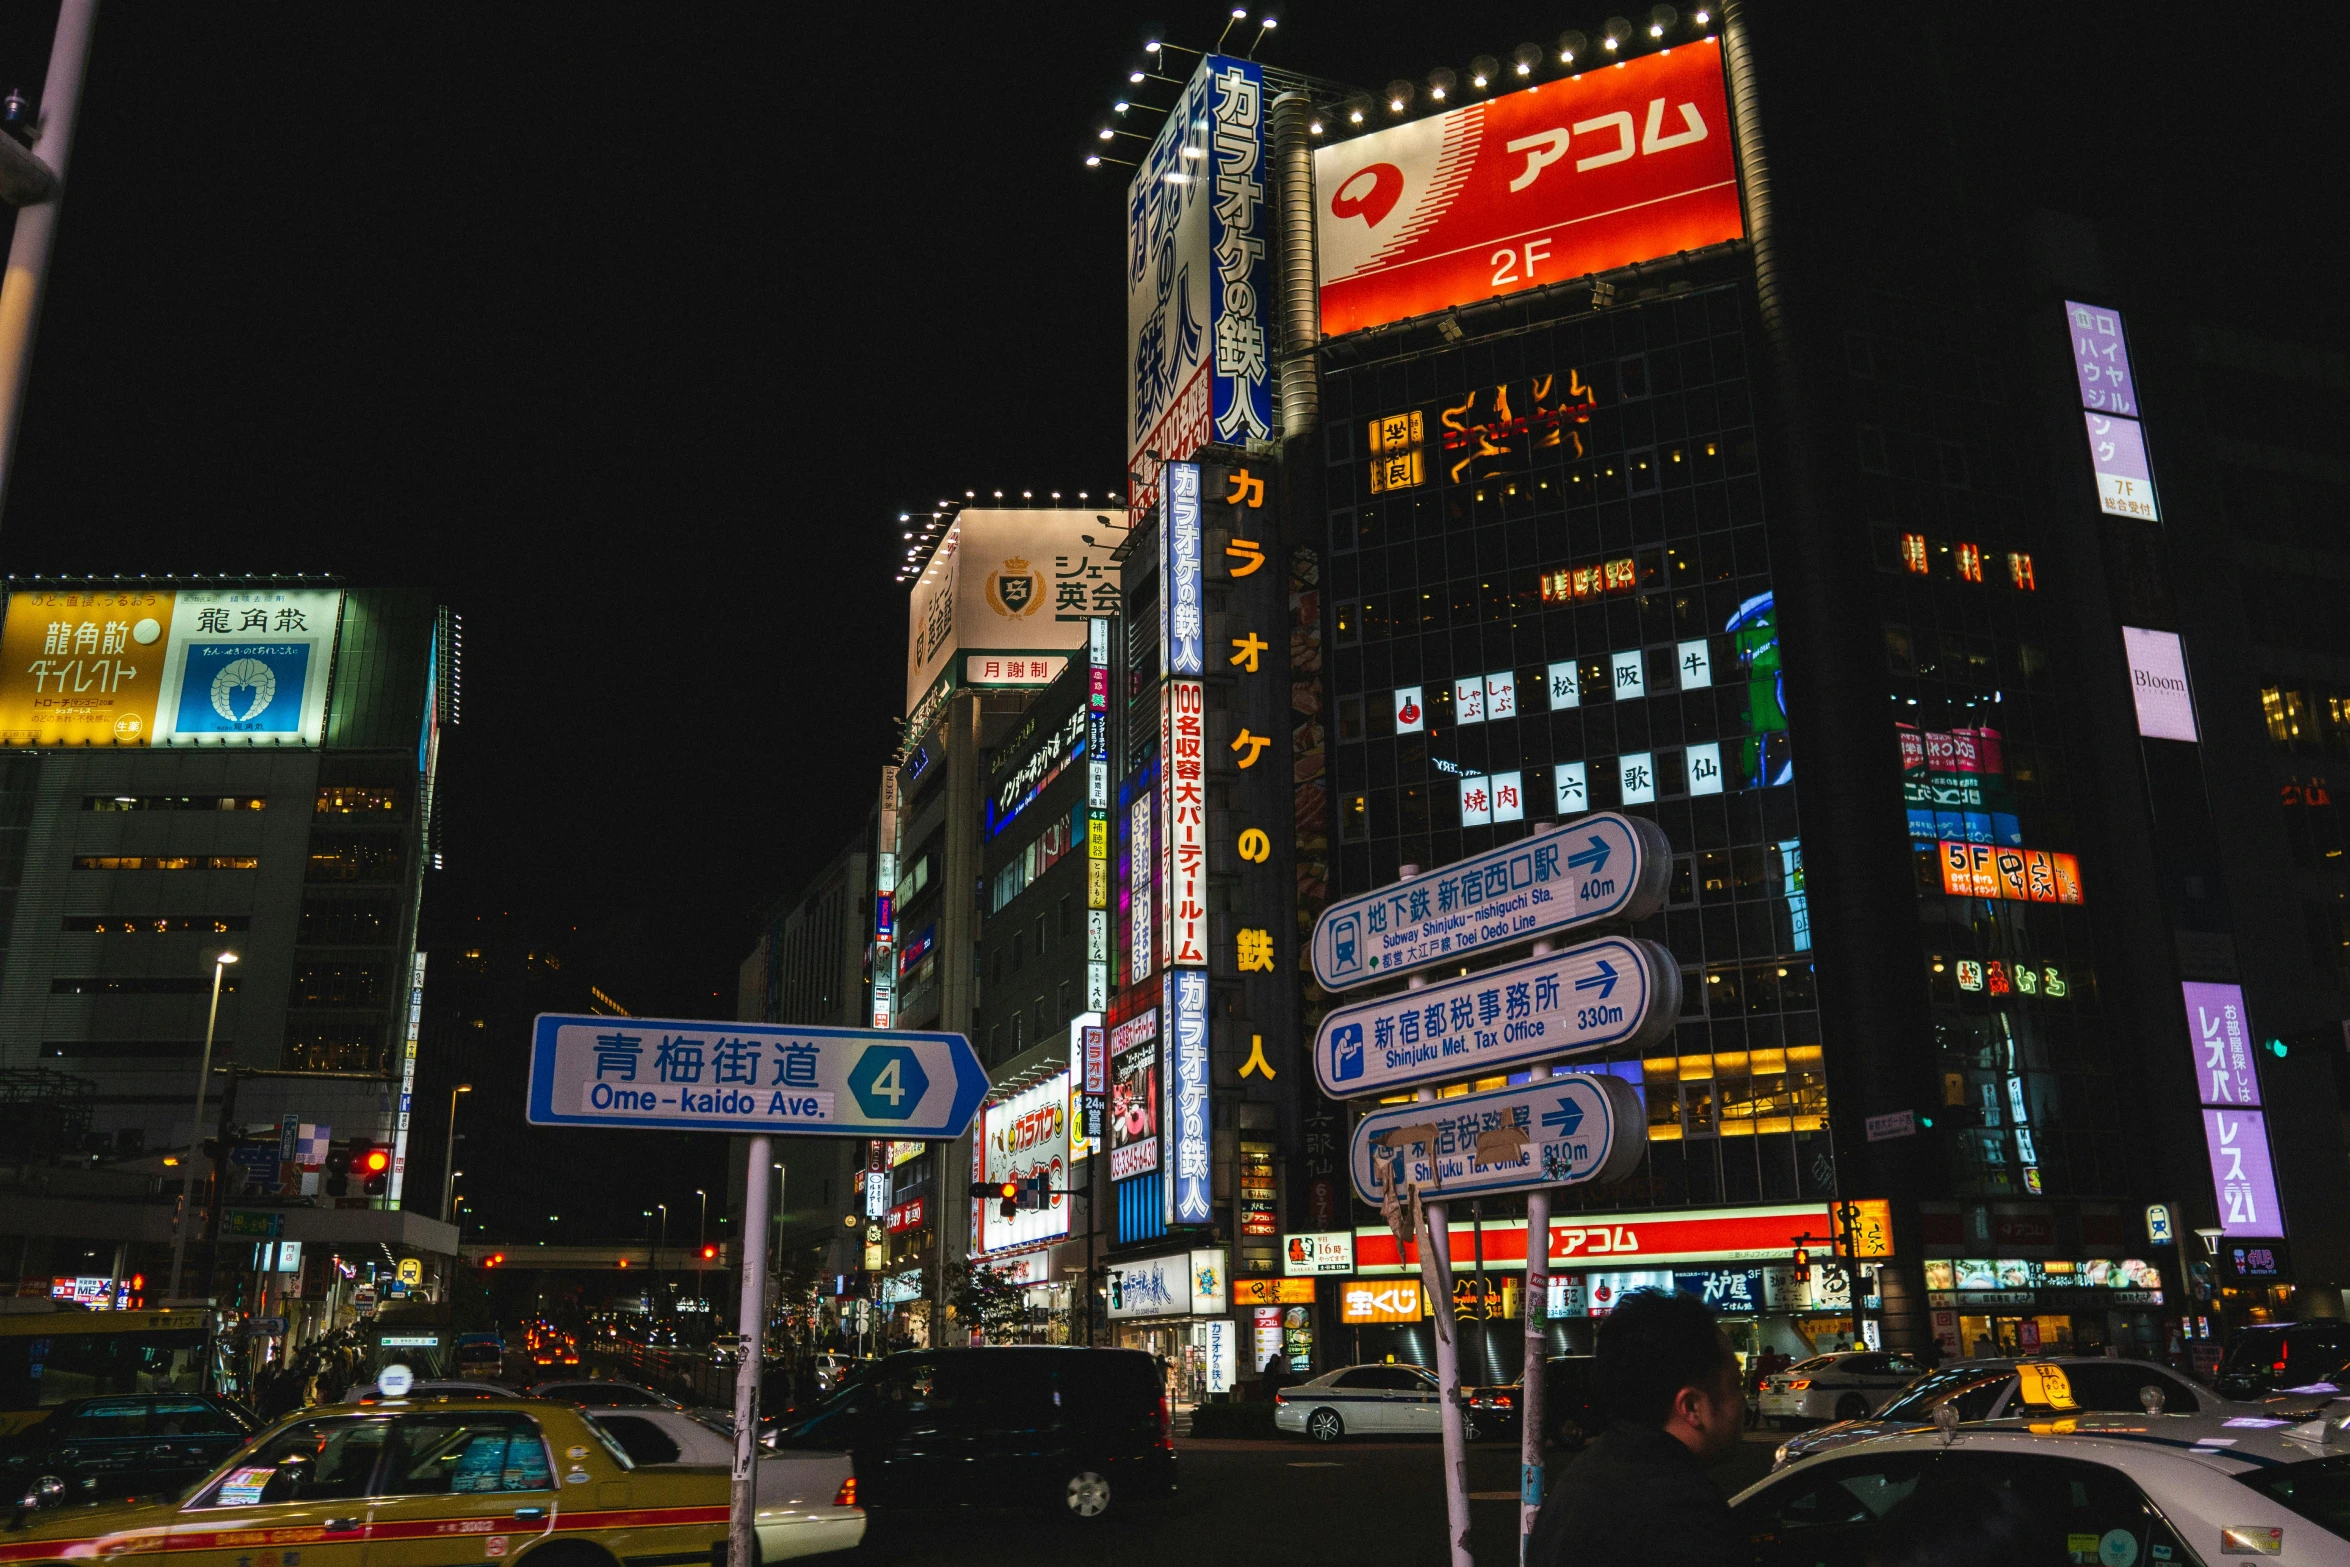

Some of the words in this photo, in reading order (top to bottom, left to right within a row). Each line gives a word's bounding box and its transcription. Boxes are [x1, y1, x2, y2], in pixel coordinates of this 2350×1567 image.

[1507, 98, 1708, 193] アコム
[1212, 66, 1270, 440] カラオケの鉄人
[1491, 237, 1552, 287] 2F
[1134, 262, 1202, 445] 鉄人
[2097, 314, 2130, 412] ロイヤル
[2080, 338, 2115, 461] ハウジング
[2115, 480, 2134, 496] 7F
[2105, 497, 2151, 516] 総合受付
[1173, 464, 1202, 673] カラオケの鉄人
[32, 595, 156, 607] のど、直接、うるおう
[44, 621, 129, 655] 龍角散
[197, 608, 309, 633] 龍角散
[28, 660, 137, 693] ダイレクト
[984, 662, 1047, 678] 月謝制
[2133, 669, 2186, 691] Bloom
[31, 715, 112, 723] のどのあれ・不快感に
[34, 699, 71, 707] トローチ
[1226, 468, 1277, 1081] カラオケの鉄人
[1091, 811, 1106, 819] 4F
[1463, 785, 1519, 814] 焼肉
[1092, 822, 1103, 857] 補聴器
[1174, 684, 1205, 962] 100名収容大パーティールーム
[1949, 845, 1989, 871] 5F
[1132, 803, 1141, 982] 03-3345-6430
[1368, 887, 1431, 935] 地下鉄
[1438, 843, 1562, 911] 新宿西口駅
[1580, 877, 1615, 903] 40m
[1383, 930, 1419, 950] Subway
[1532, 886, 1554, 904] Sta.
[1382, 950, 1403, 970] 都営
[1407, 938, 1452, 963] 大江戸線
[1456, 931, 1478, 949] Toei
[1481, 921, 1509, 942] Oedo
[1513, 915, 1536, 934] Line
[1374, 972, 1560, 1050] 新宿都税事務所
[1577, 1005, 1623, 1031] 330m
[593, 1032, 821, 1089] 青梅街道
[1087, 1030, 1102, 1090] カラオケ
[1386, 1039, 1439, 1068] Shinjuku
[1442, 1037, 1469, 1057] Met.
[1474, 1030, 1498, 1049] Tax
[1503, 1019, 1545, 1041] Office
[2224, 1004, 2252, 1103] お部屋探しは
[871, 1059, 906, 1106] 4
[1178, 972, 1209, 1218] カラオケの鉄人
[590, 1083, 755, 1116] Ome-kaido
[767, 1091, 825, 1119] Ave.
[1085, 1097, 1105, 1111] 24H
[1014, 1106, 1056, 1150] カラオケ
[1088, 1109, 1101, 1135] 営業
[1415, 1159, 1463, 1182] Shijuku
[1561, 1226, 1639, 1255] アコム
[1748, 1270, 1762, 1278] 3F
[2248, 1250, 2275, 1268] HUB
[1123, 1261, 1172, 1311] カラオケの鉄人
[1347, 1289, 1417, 1315] 宝くじ
[1702, 1270, 1753, 1304] 大戸屋
[1258, 1318, 1278, 1326] アコム
[1212, 1322, 1223, 1391] カラオケの鉄人
